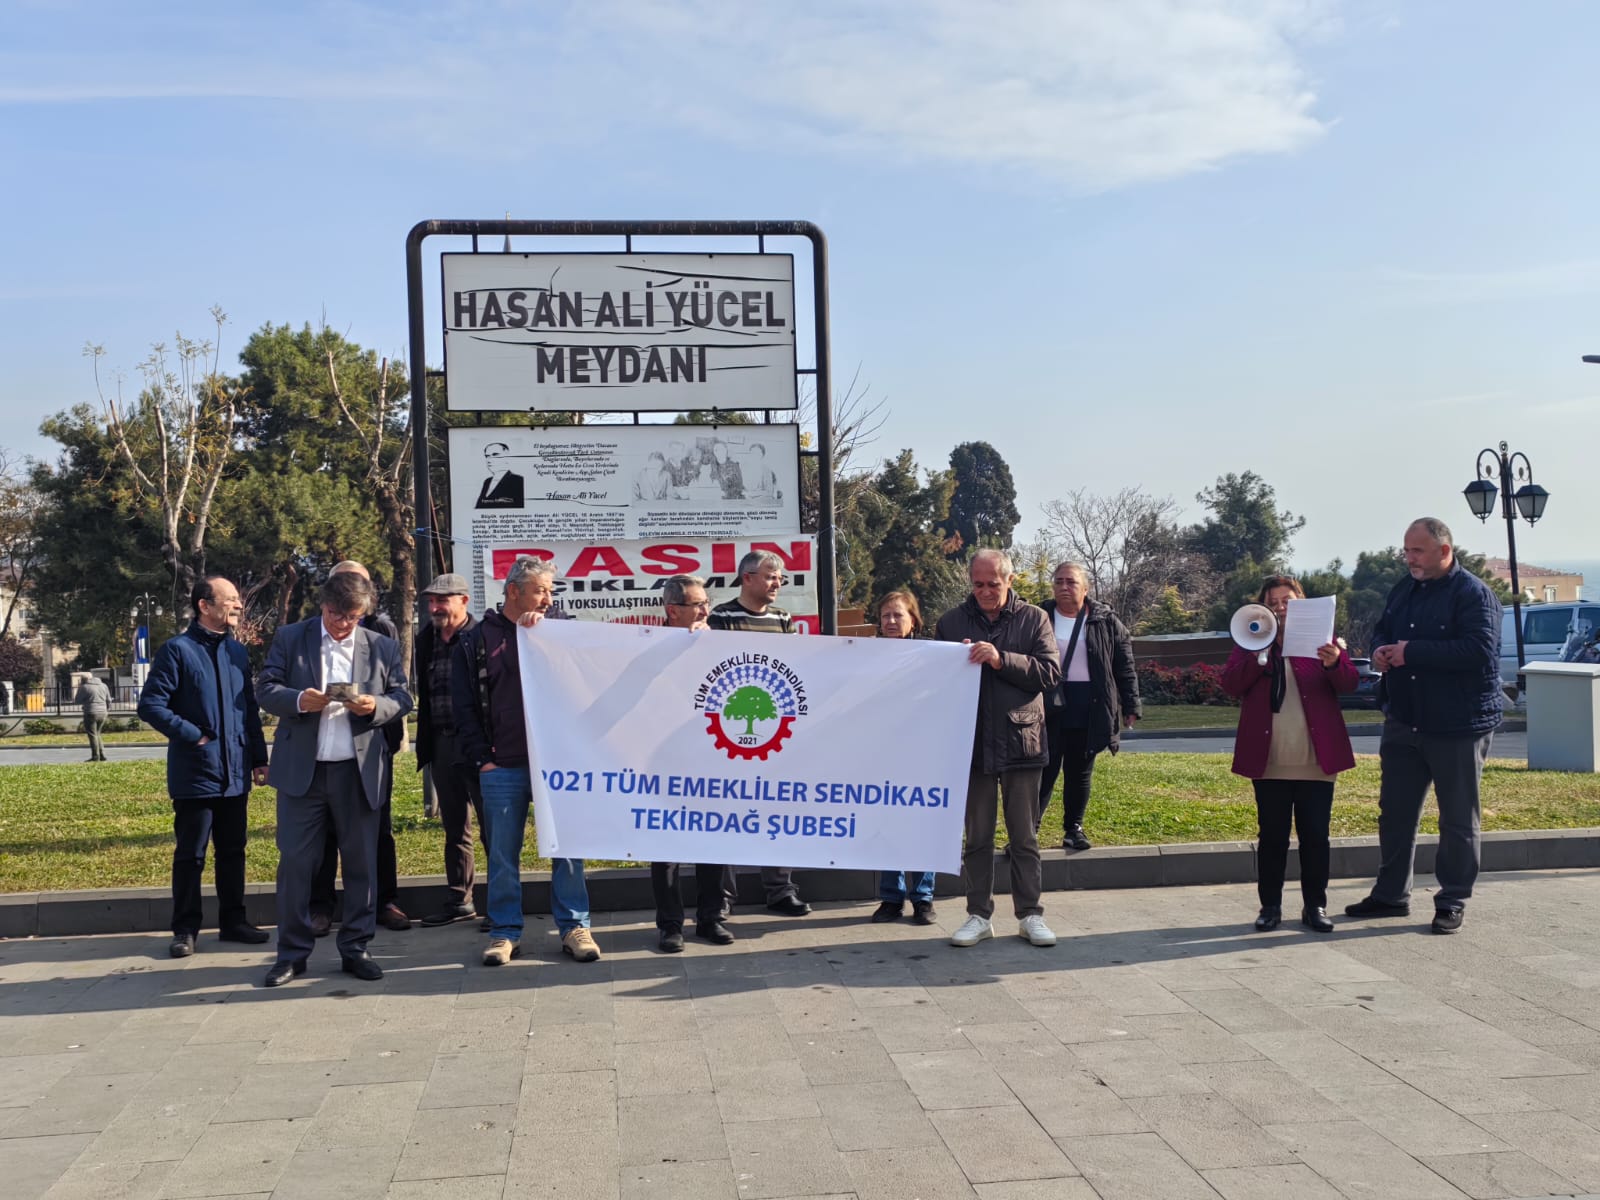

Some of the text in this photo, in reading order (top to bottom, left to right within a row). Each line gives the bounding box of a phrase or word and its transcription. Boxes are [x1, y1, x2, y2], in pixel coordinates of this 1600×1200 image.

[454, 281, 786, 328] HASAN ALİ YÜCEL
[537, 347, 707, 383] MEYDANI
[546, 491, 571, 500] Hasan
[572, 491, 586, 499] Ali
[694, 651, 809, 716] TÜM EMEKLİLER SENDİKASI
[738, 736, 757, 745] 2021
[541, 768, 949, 808] 021 TÜM EMEKLİLER SENDİKASI
[631, 805, 856, 841] TEKİRDAĞ ŞUBESİ
